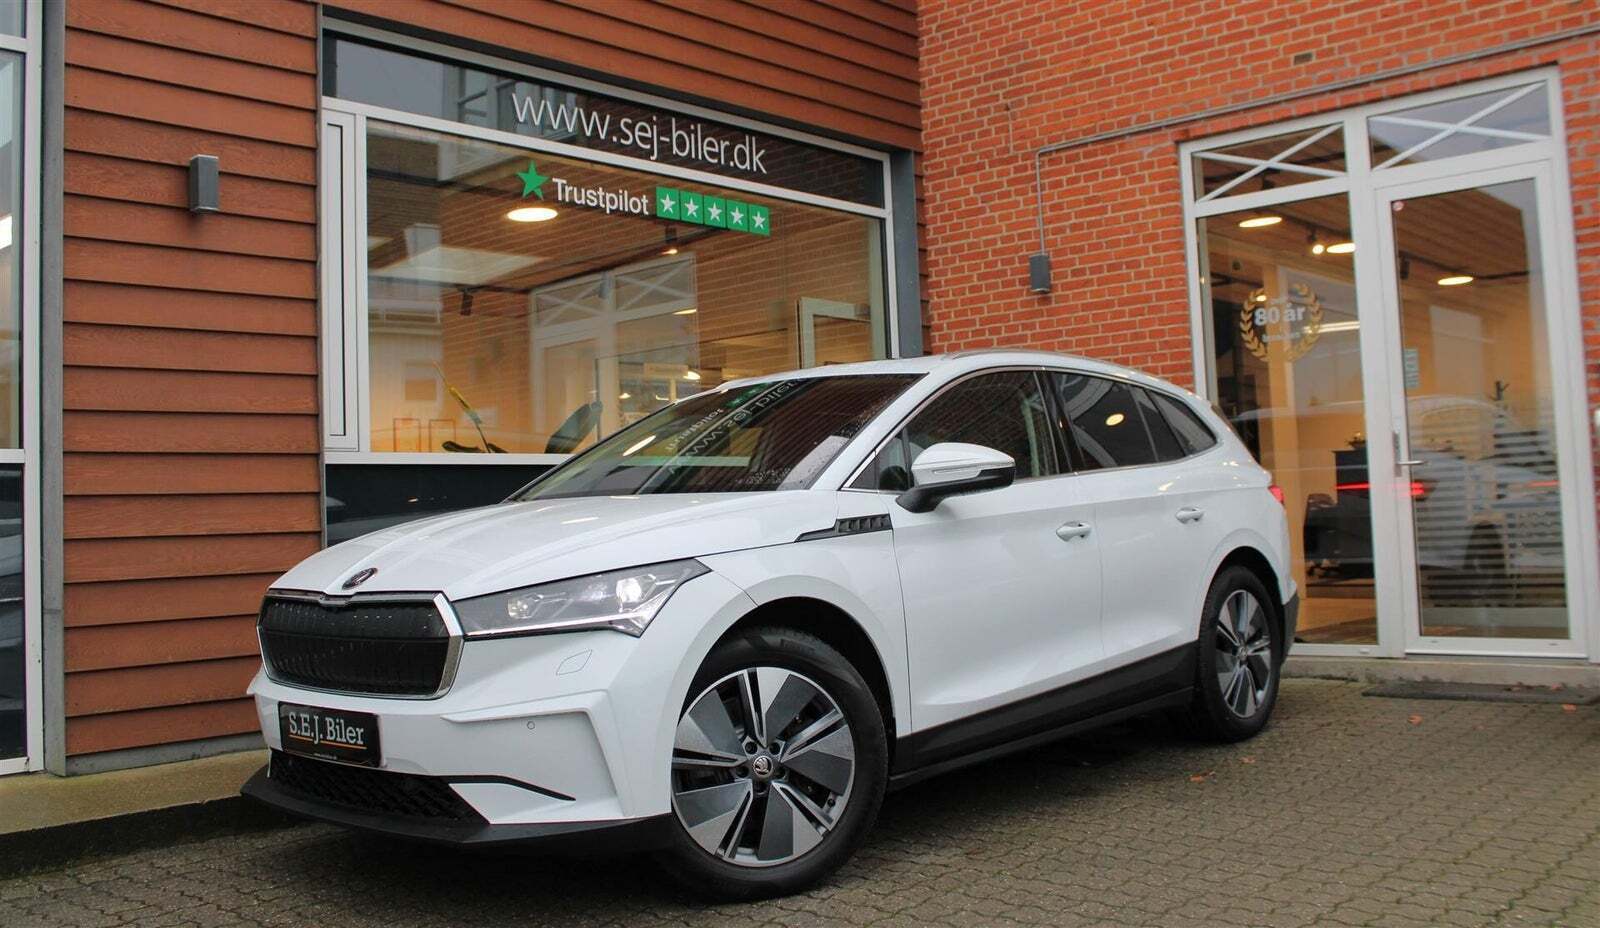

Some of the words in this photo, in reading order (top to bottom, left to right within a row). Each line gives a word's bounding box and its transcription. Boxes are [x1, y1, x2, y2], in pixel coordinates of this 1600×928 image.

[512, 93, 767, 174] www.sej-biler.dk
[552, 178, 649, 214] Trustpilot
[1254, 307, 1280, 326] 80
[1284, 303, 1306, 322] år
[289, 711, 323, 744] S.E.J.
[326, 717, 364, 744] Biler
